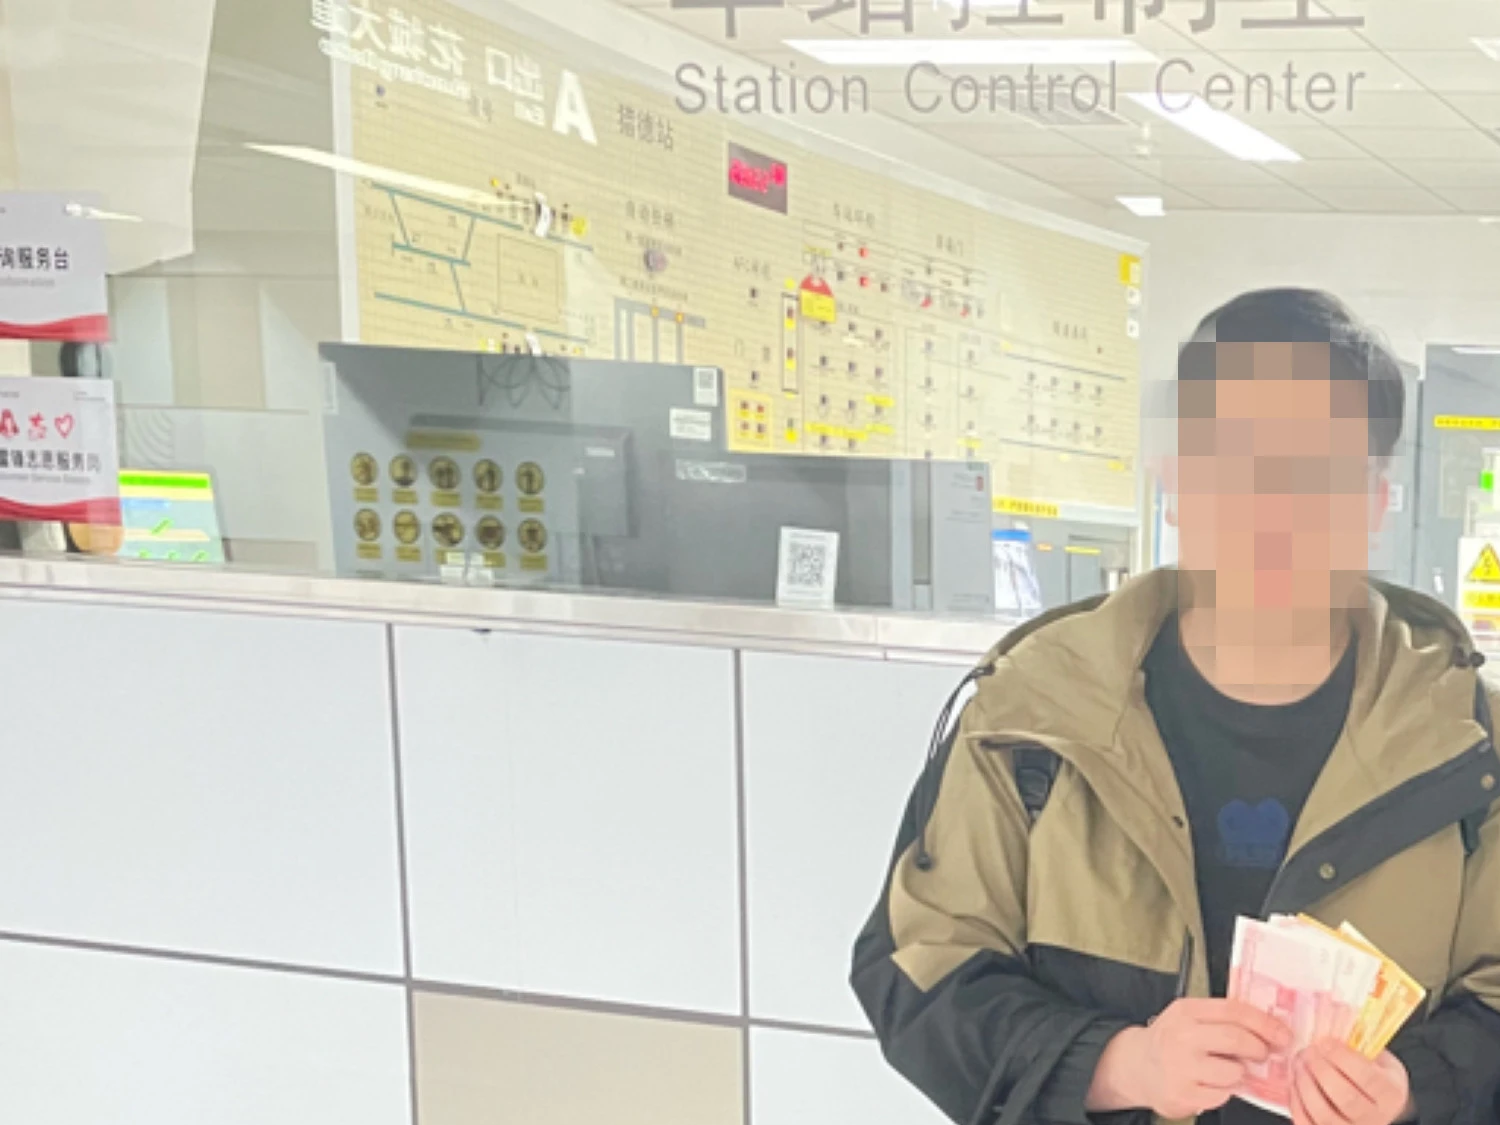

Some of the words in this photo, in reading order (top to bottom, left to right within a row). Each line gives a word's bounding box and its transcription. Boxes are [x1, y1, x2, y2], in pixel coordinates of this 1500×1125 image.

[673, 61, 869, 114] Station
[904, 59, 1117, 115] Control
[1155, 58, 1366, 114] Center
